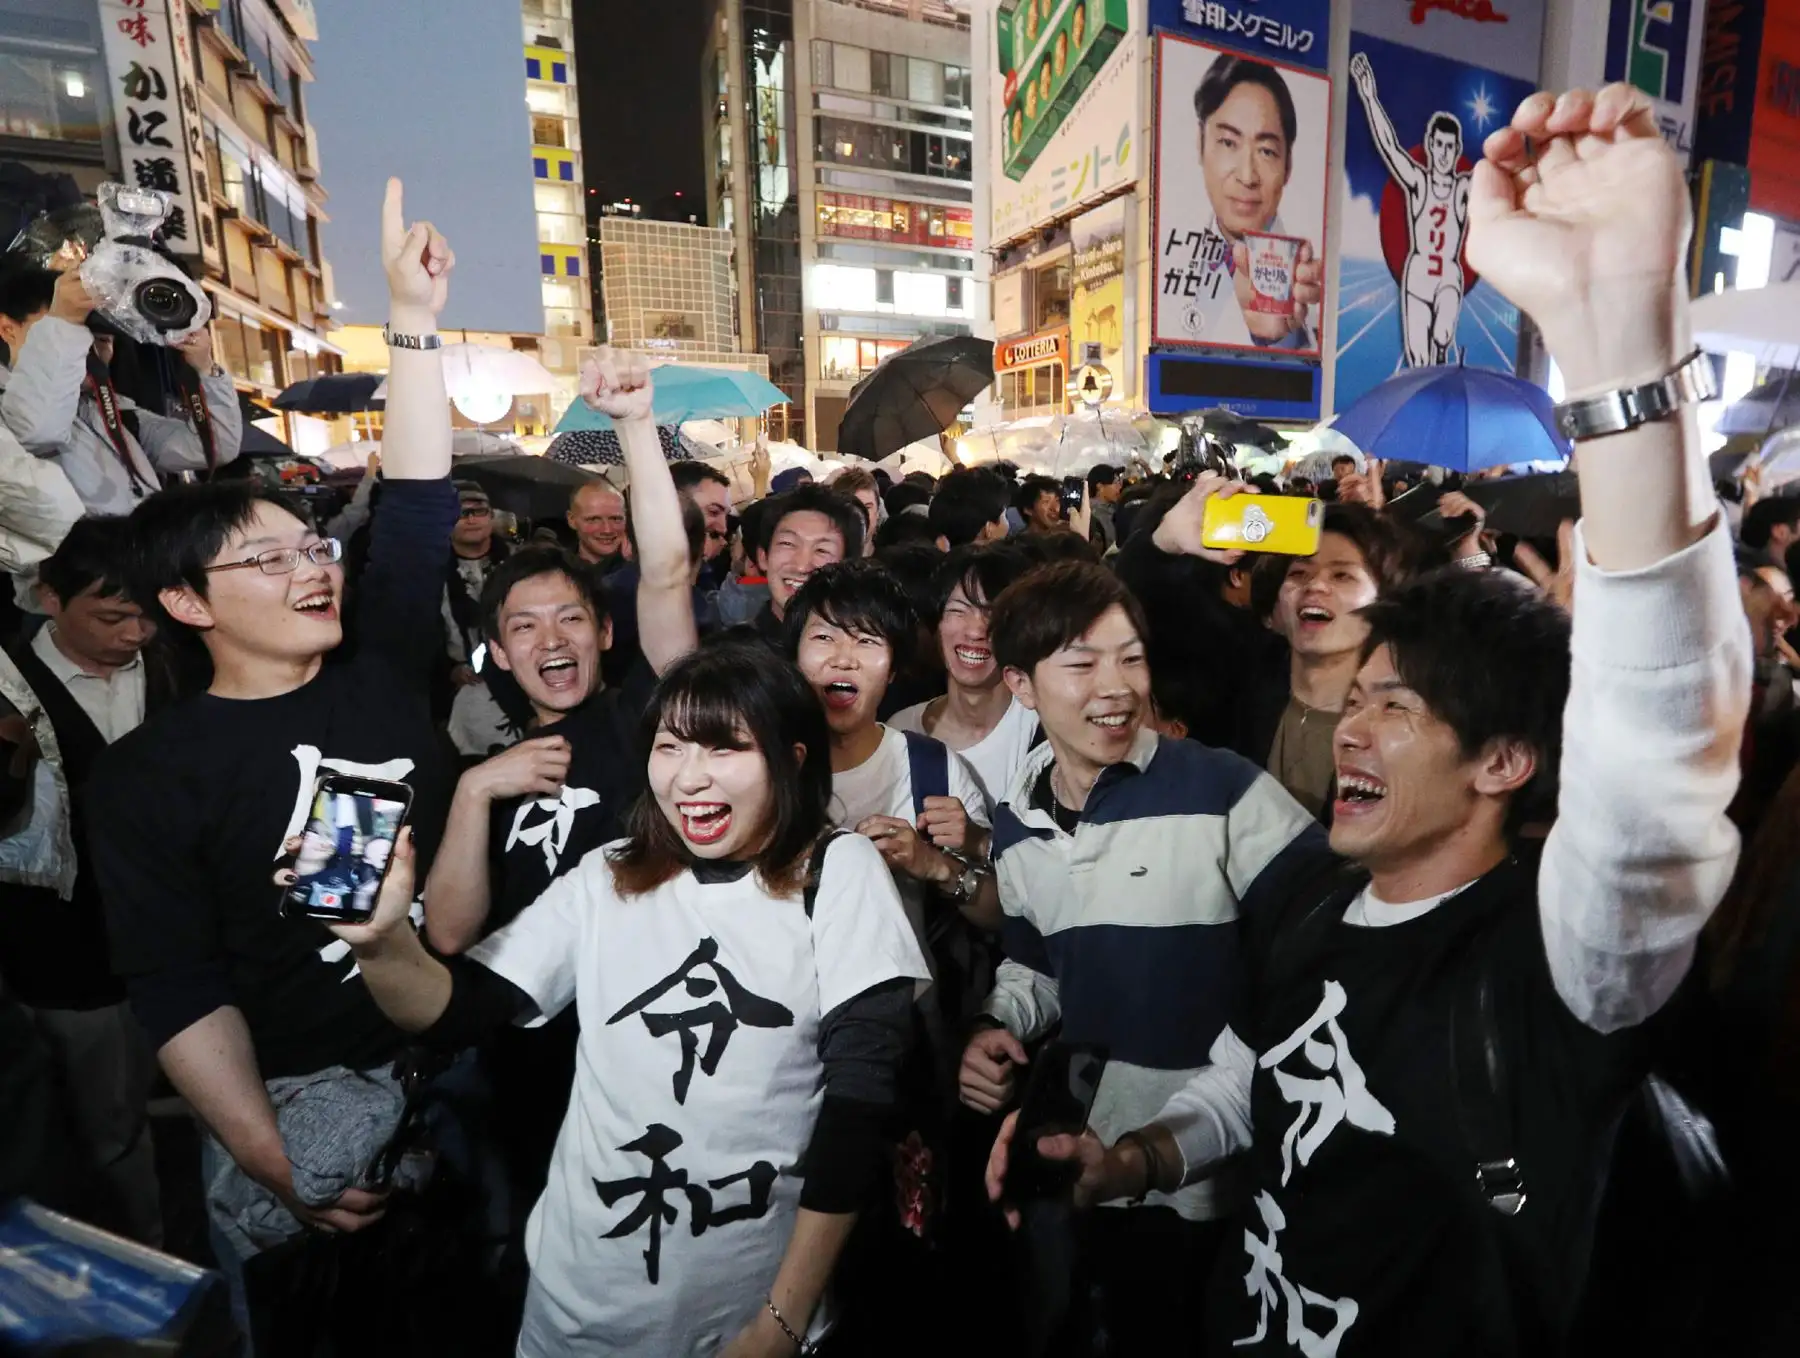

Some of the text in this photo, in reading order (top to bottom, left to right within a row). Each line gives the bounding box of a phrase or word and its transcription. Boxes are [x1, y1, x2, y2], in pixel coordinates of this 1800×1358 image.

[1182, 0, 1315, 52] 雪印メグミルク
[1164, 227, 1224, 262] トクホ
[1427, 202, 1450, 277] グリコ
[1163, 267, 1222, 300] ガセリ
[1013, 337, 1058, 362] LOTTERIA
[99, 385, 117, 430] Canon
[592, 936, 795, 1285] 令和
[1232, 980, 1397, 1358] 令和
